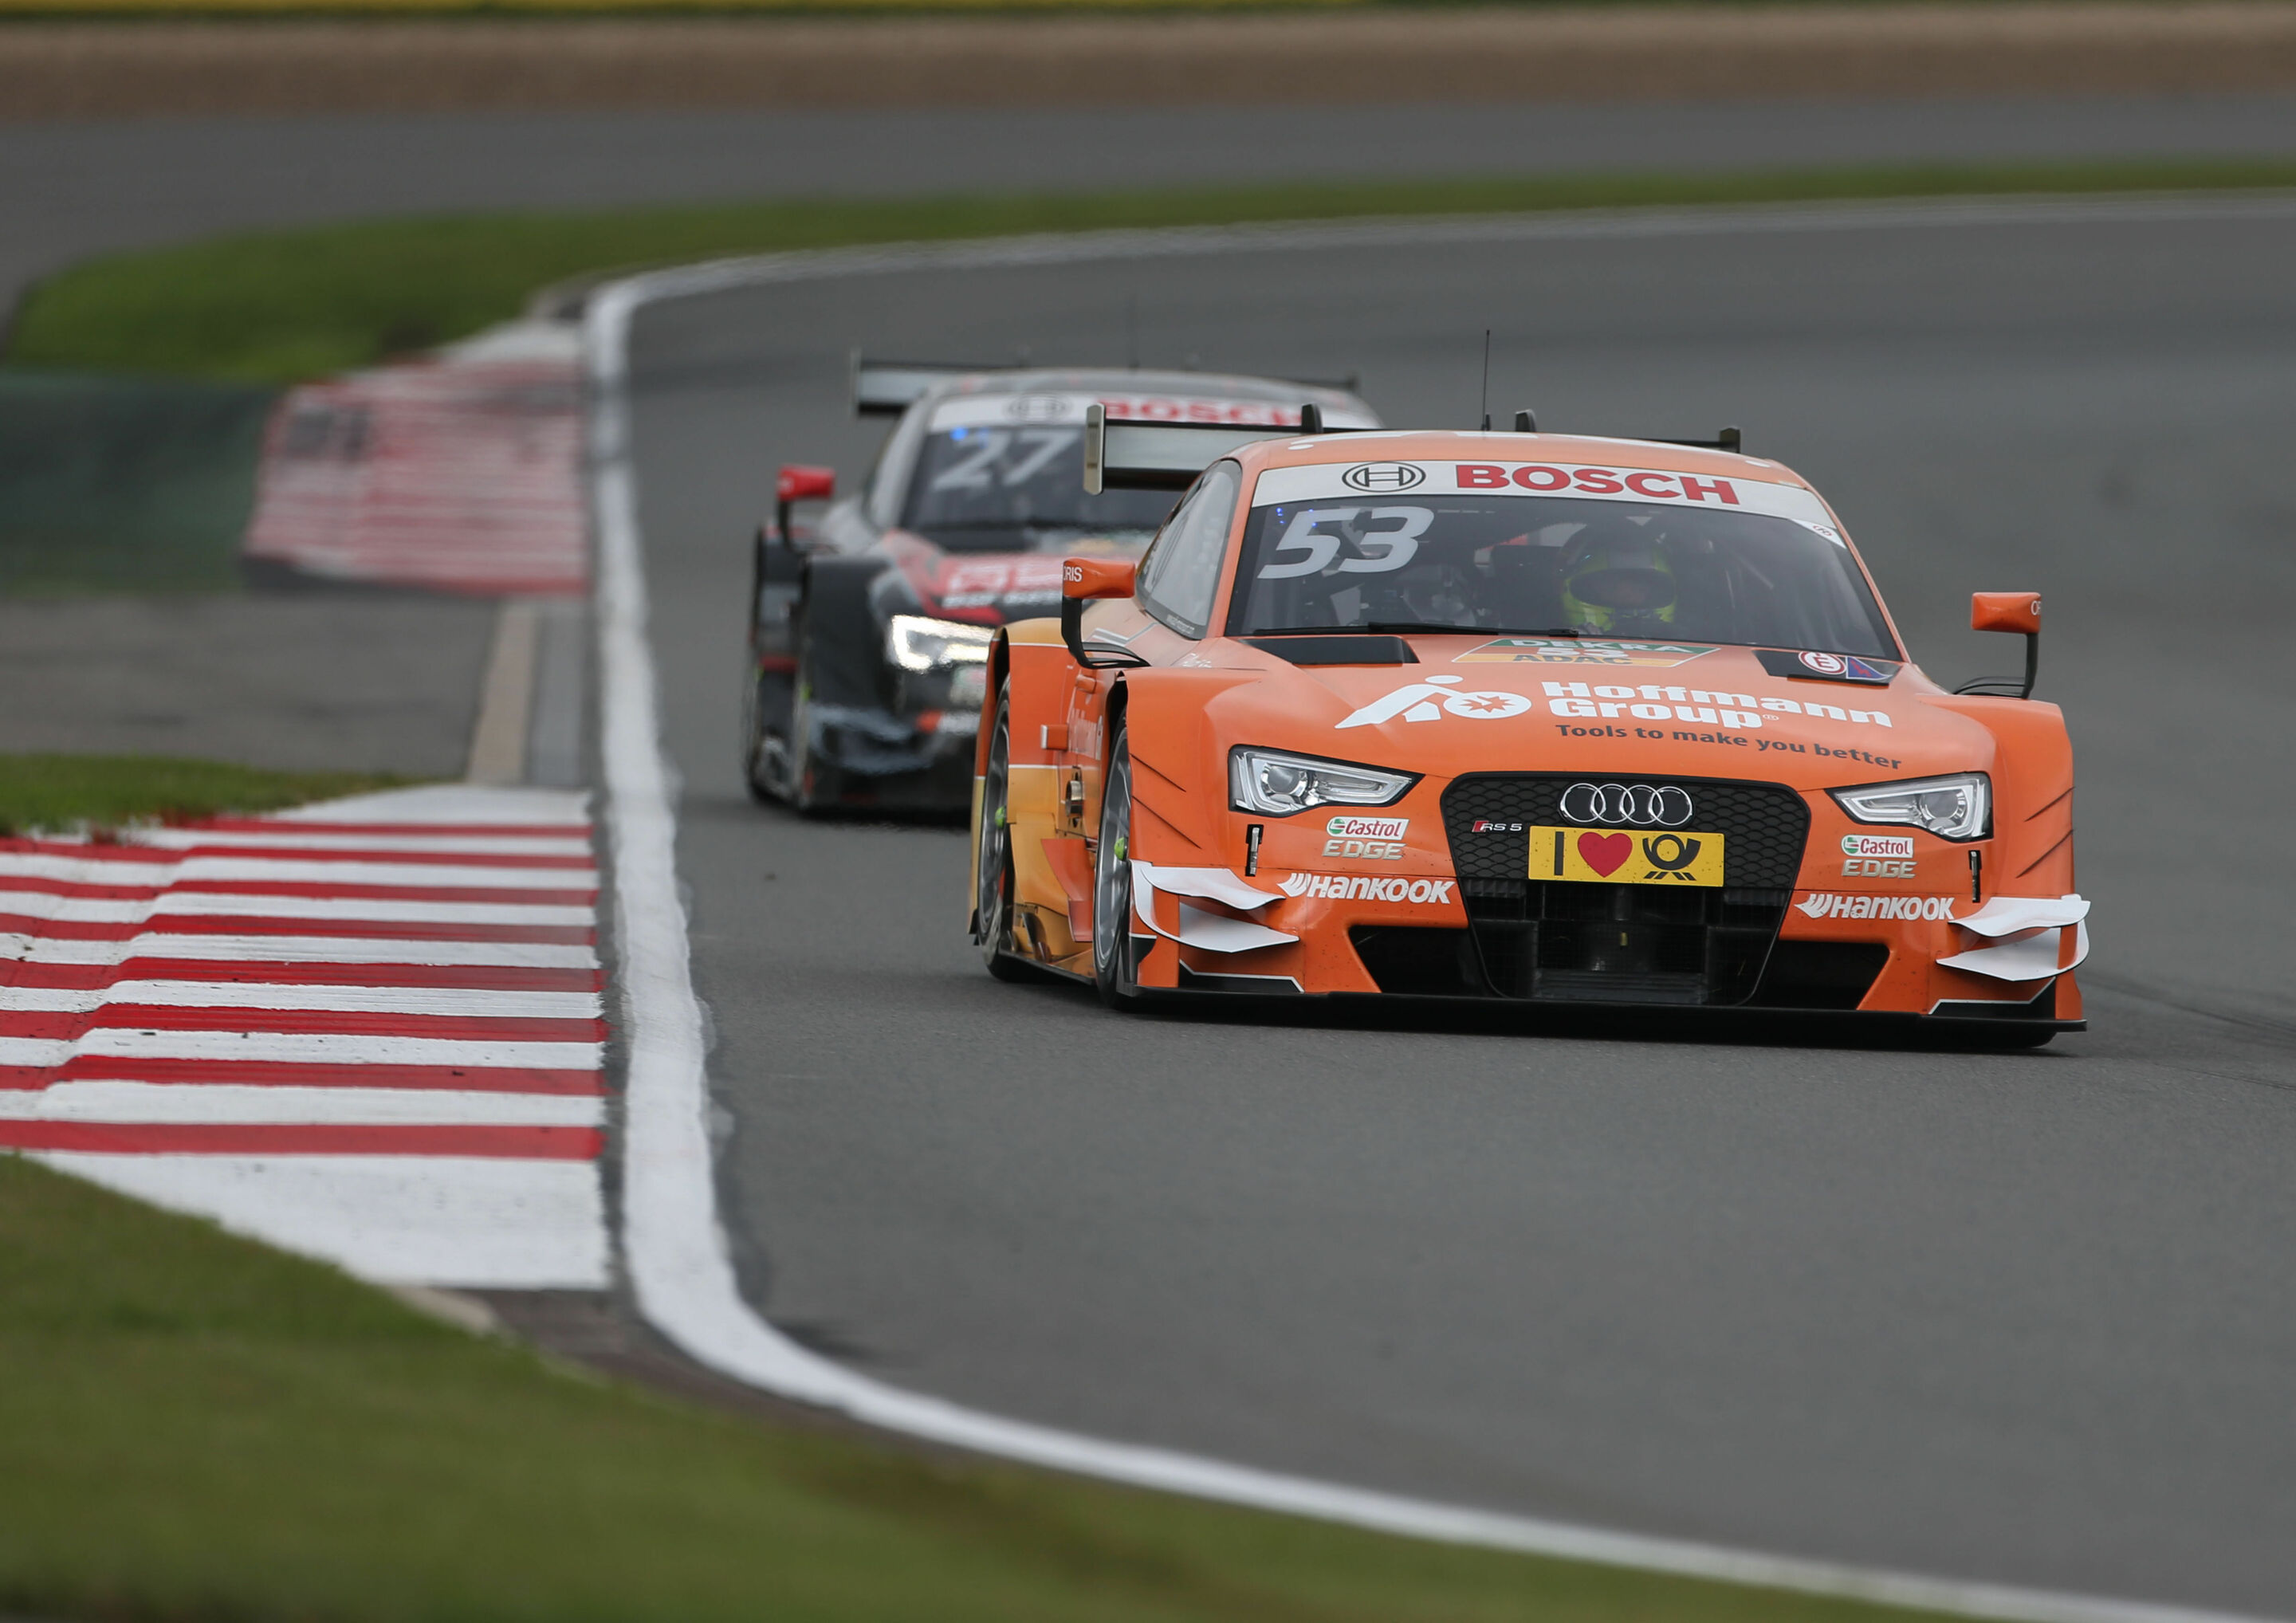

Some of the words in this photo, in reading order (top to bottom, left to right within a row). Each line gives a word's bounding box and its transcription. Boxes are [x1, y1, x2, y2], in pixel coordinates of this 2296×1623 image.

[932, 430, 1077, 489] 27
[1455, 464, 1740, 505] BOSCH
[1257, 506, 1434, 580] 53
[1511, 639, 1695, 654] DEKRA
[1537, 646, 1630, 658] 53
[1512, 654, 1633, 666] ADAC
[1540, 681, 1893, 729] Hoffmann
[1555, 724, 1628, 739] Tools
[1634, 727, 1665, 740] to
[1672, 729, 1748, 748] make
[1755, 737, 1807, 754] you
[1813, 743, 1902, 770] better
[1345, 819, 1402, 837] Castrol
[1477, 822, 1507, 831] RS
[1509, 823, 1523, 831] 5
[1323, 839, 1406, 860] EDGE
[1860, 838, 1910, 855] Castrol
[1842, 859, 1917, 878] EDGE
